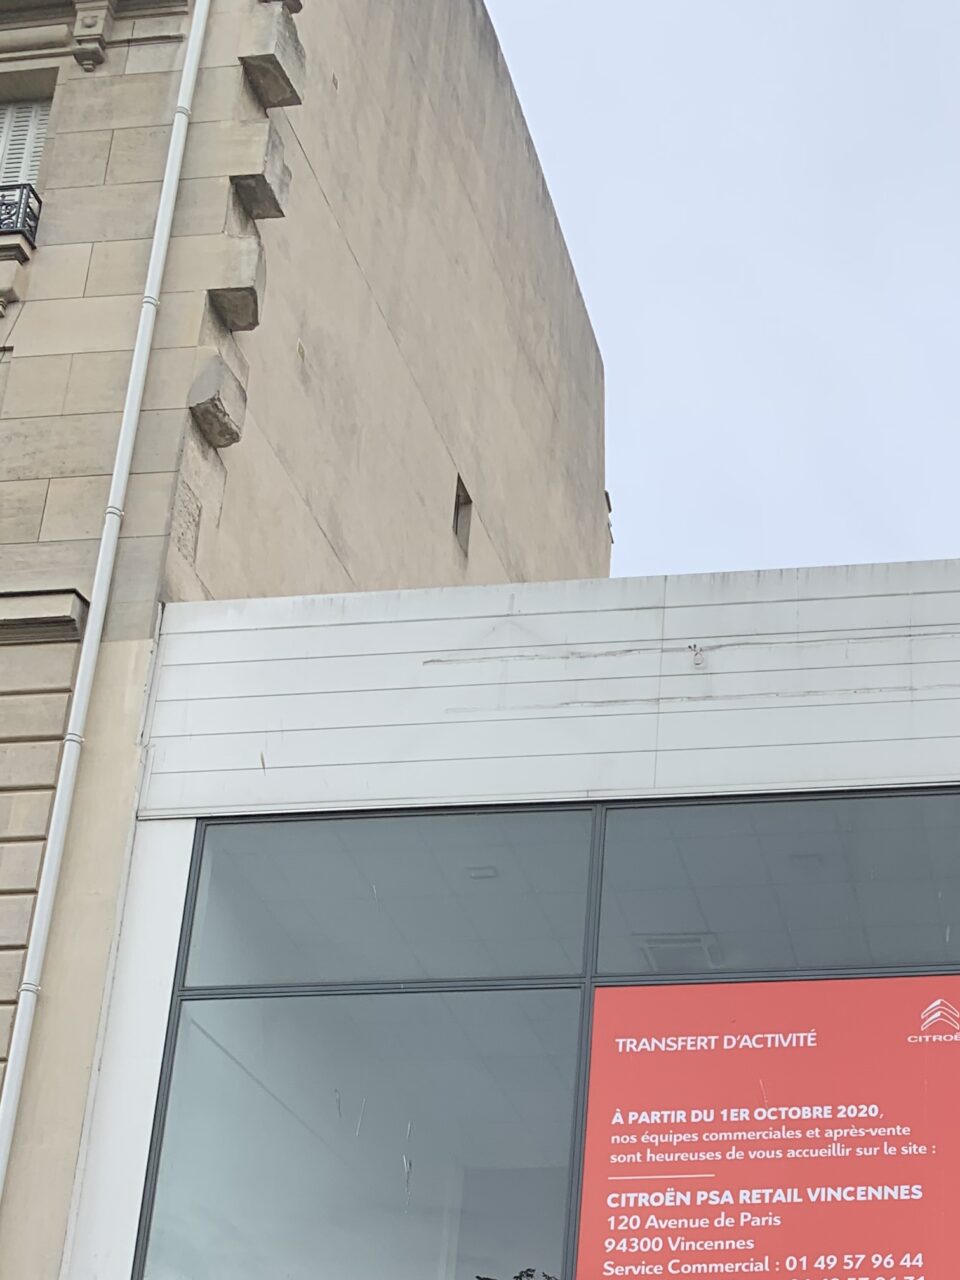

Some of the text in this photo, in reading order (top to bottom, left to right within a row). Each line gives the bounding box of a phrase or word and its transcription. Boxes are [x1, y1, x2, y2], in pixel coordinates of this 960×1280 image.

[616, 1029, 817, 1053] TRANSFERT D'ACTIVITÉ
[612, 1104, 883, 1125] À PARTIR DU 1ER OCTOBRE 2020,
[611, 1123, 910, 1147] nos équipes commerciales et après-vente
[610, 1150, 642, 1164] sont
[647, 1147, 722, 1162] heureuses
[726, 1145, 744, 1160] de
[748, 1148, 782, 1159] vous
[786, 1143, 851, 1159] accueillir
[856, 1145, 880, 1156] sur
[884, 1142, 897, 1155] le
[901, 1141, 927, 1155] site
[607, 1184, 922, 1208] CITROËN PSA RETAIL VINCENNES
[607, 1212, 781, 1230] 120 Avenue de Paris
[604, 1236, 754, 1253] 94300 Vincennes
[603, 1260, 663, 1276] Service
[668, 1258, 769, 1275] Commercial
[786, 1256, 807, 1271] 01
[814, 1255, 838, 1270] 49
[843, 1254, 865, 1270] 57
[871, 1254, 894, 1269] 96
[900, 1253, 923, 1269] 44
